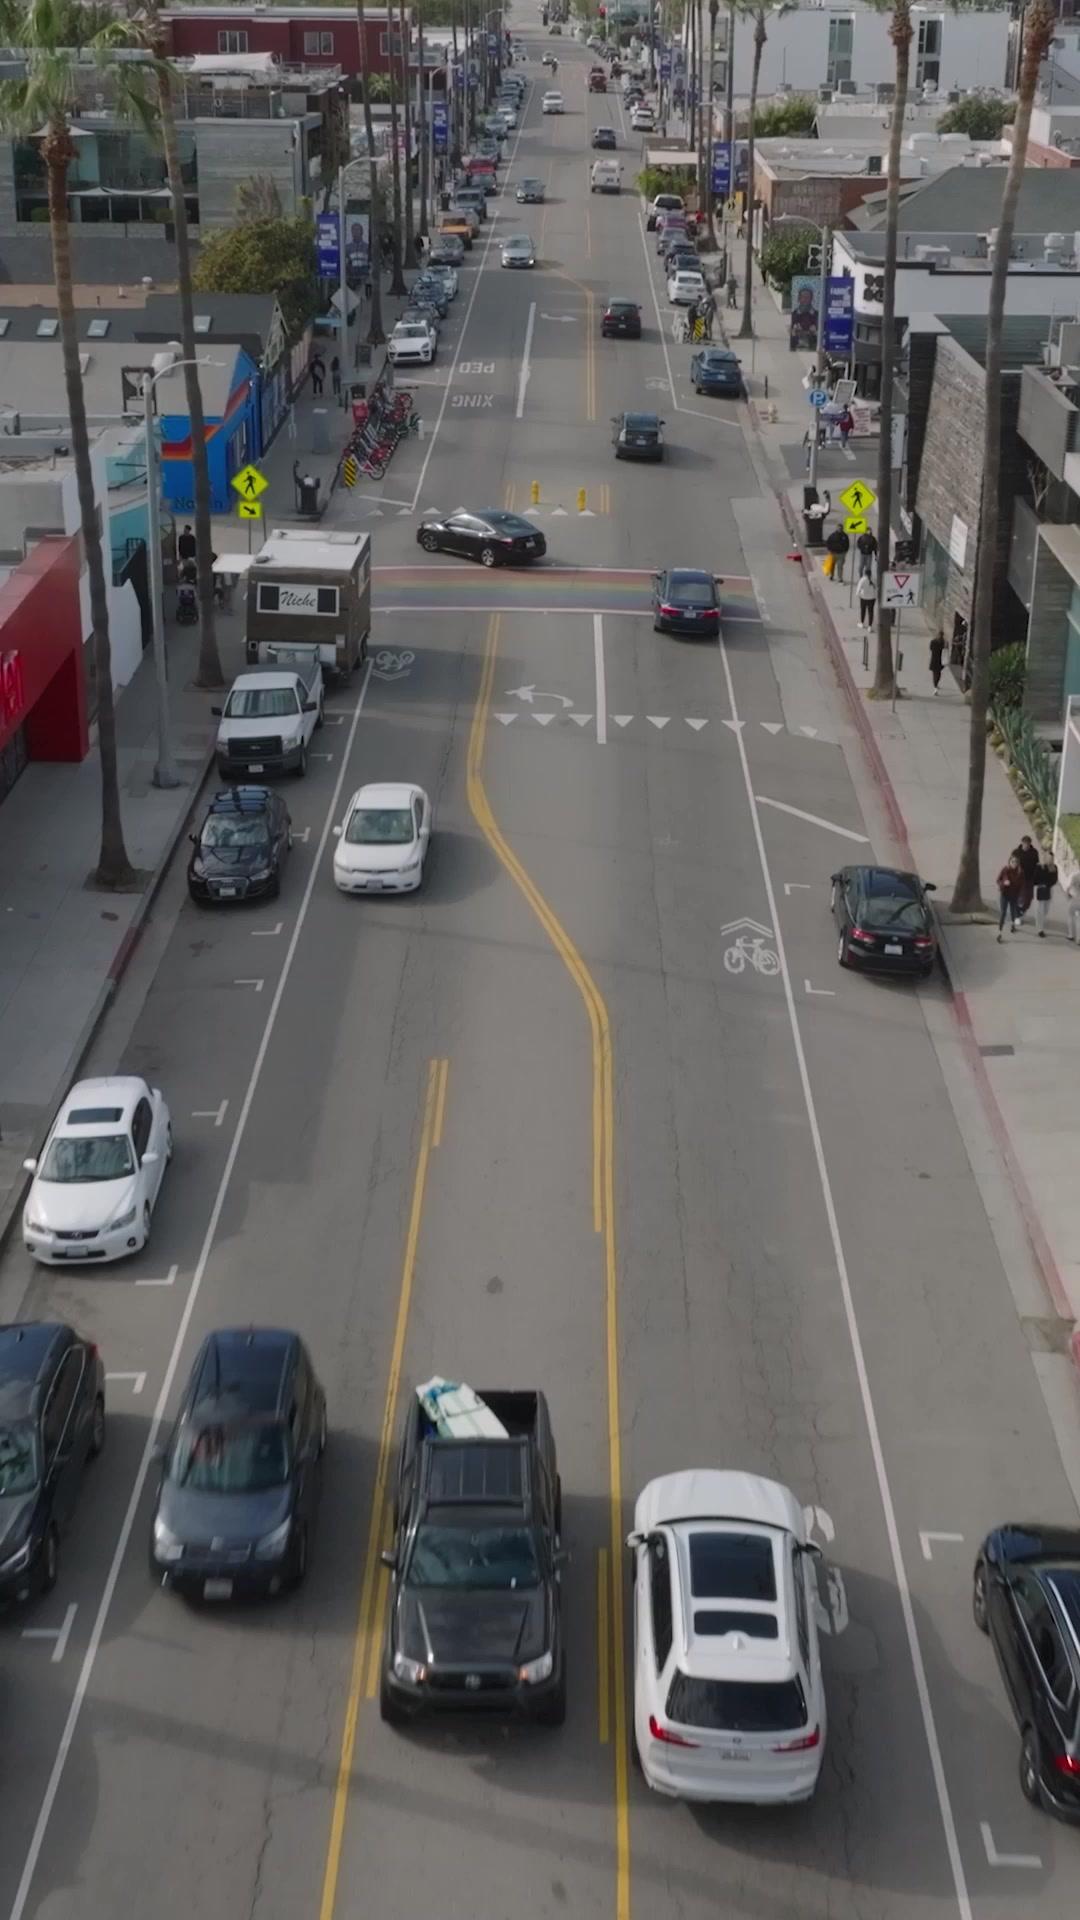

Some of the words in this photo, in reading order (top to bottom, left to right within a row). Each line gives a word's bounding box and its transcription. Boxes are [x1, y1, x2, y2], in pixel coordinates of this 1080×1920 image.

[459, 362, 495, 373] PED
[451, 394, 494, 407] XING
[280, 591, 317, 607] Niche
